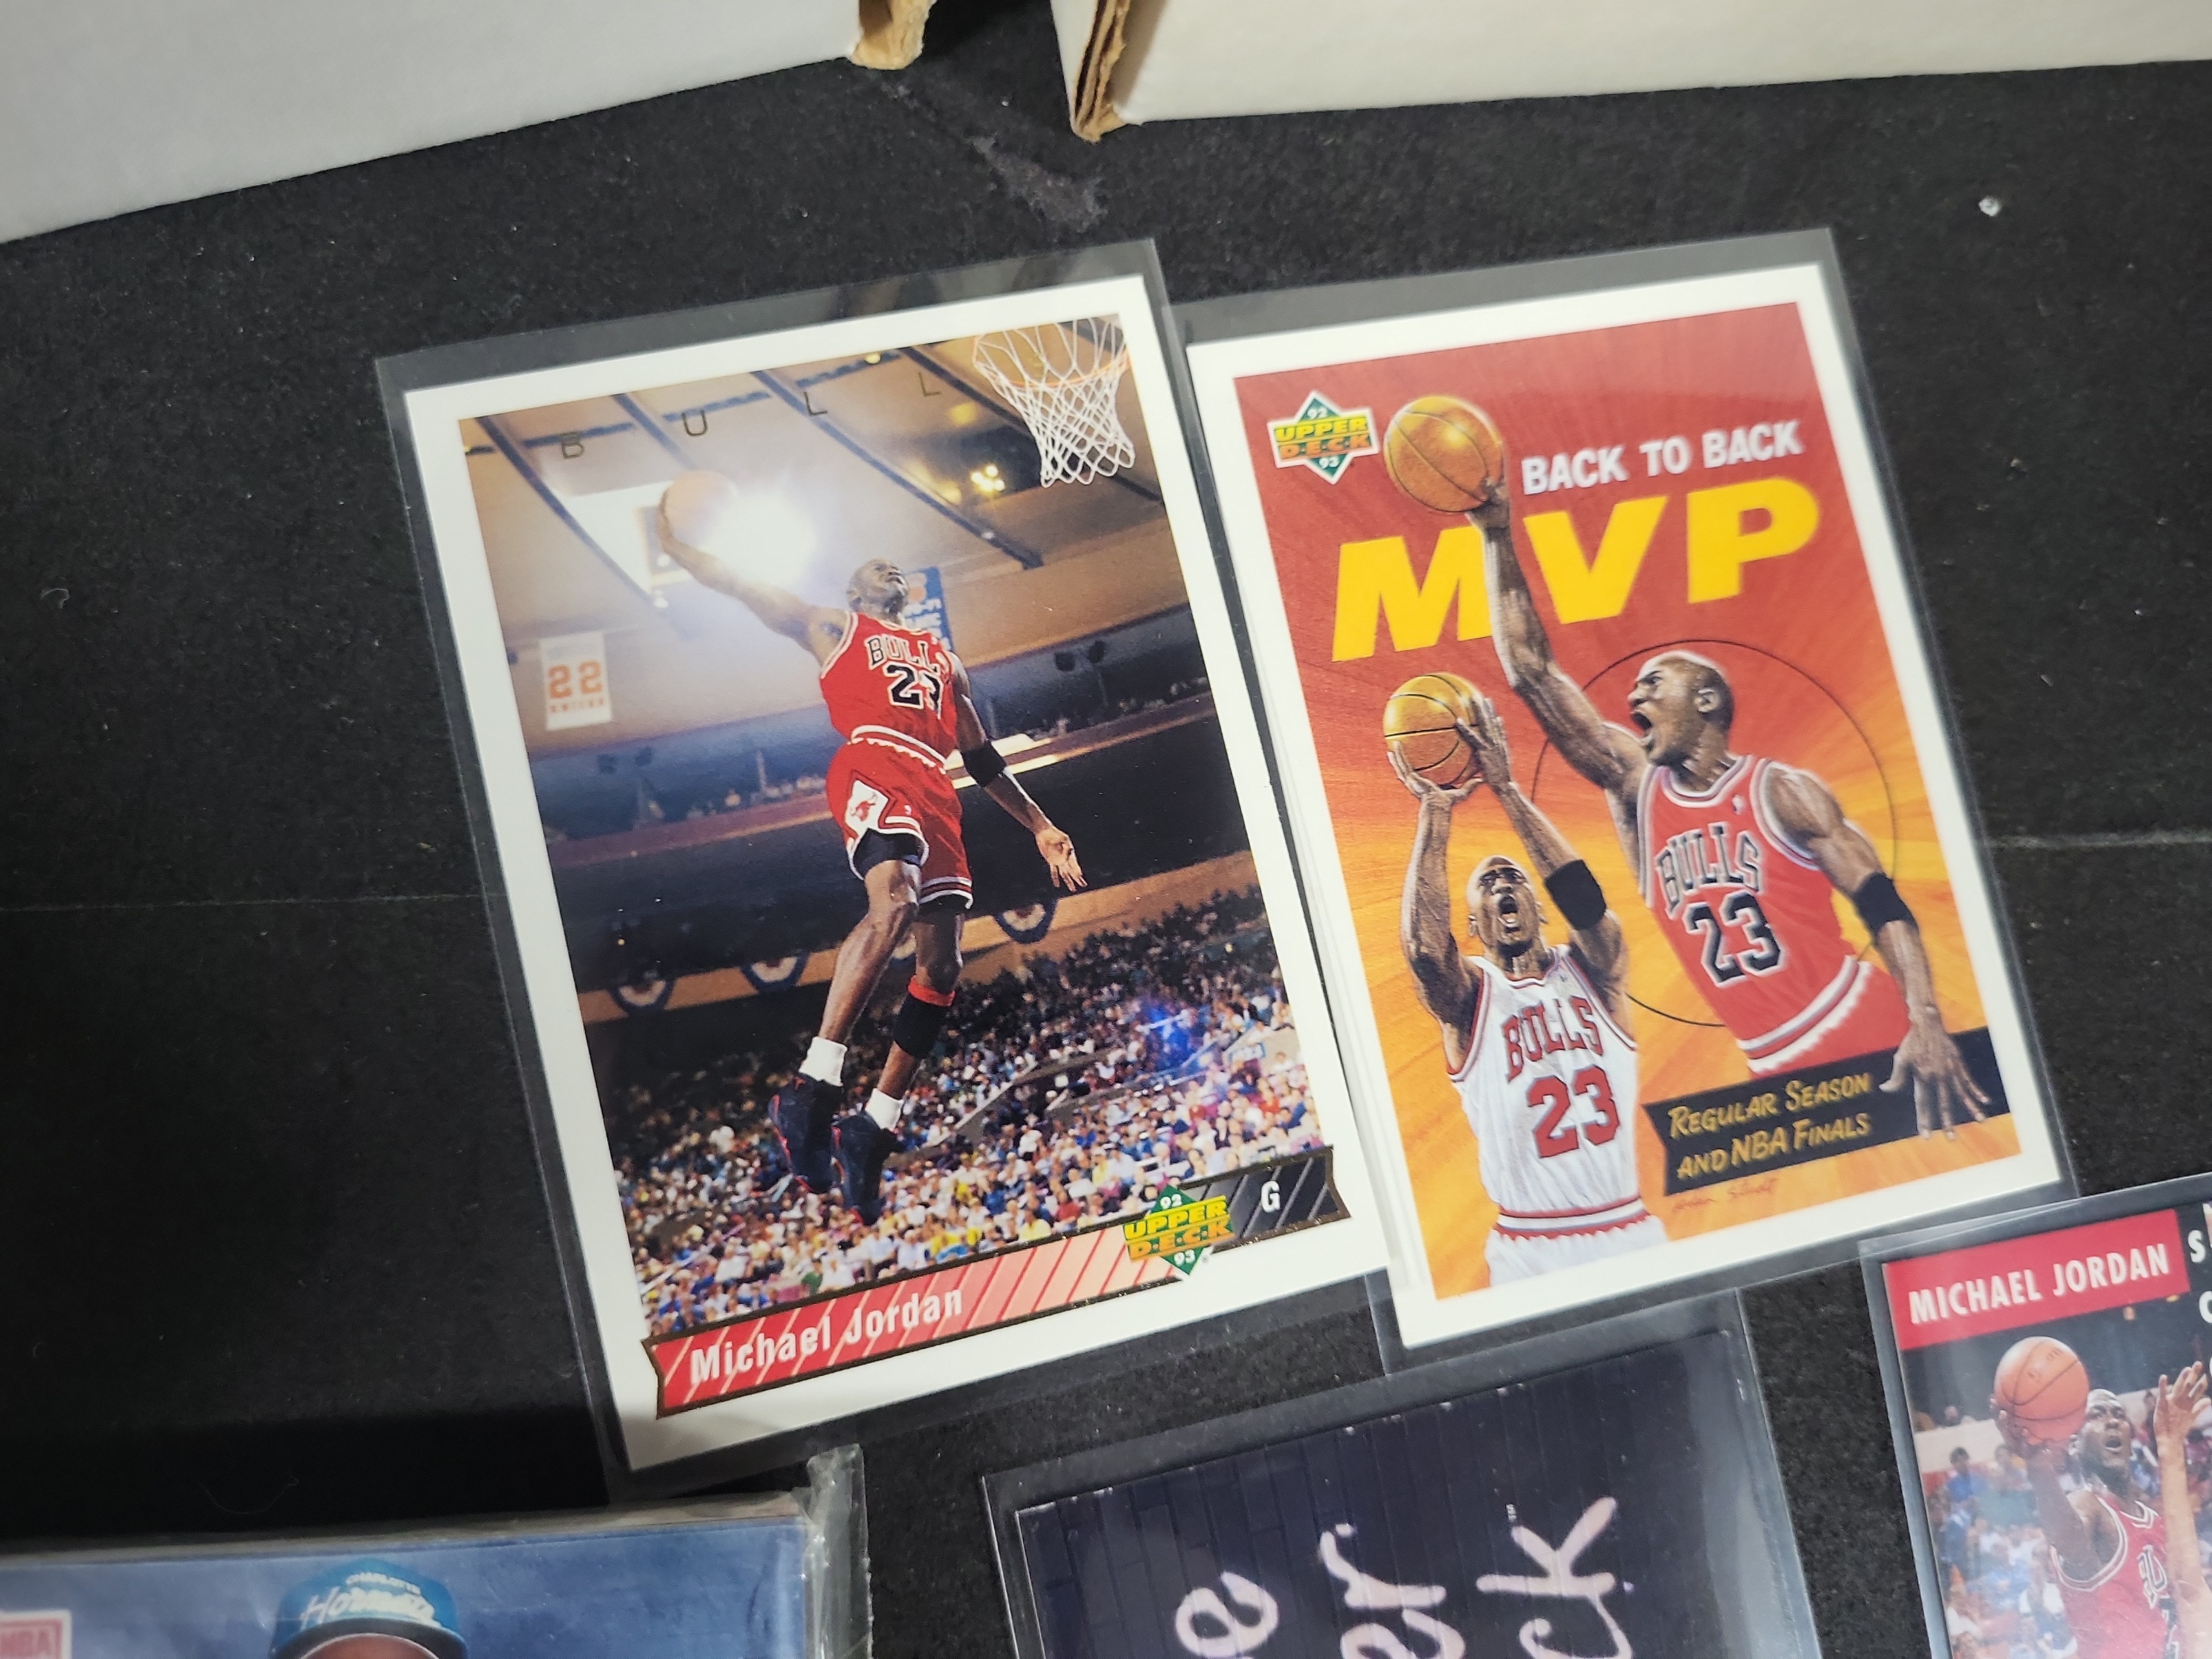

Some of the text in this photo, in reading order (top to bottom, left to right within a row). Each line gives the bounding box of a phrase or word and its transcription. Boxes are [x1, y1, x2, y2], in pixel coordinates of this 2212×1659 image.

[1275, 417, 1368, 442] UPPER
[1318, 456, 1339, 470] 93
[1521, 419, 1804, 495] BACK TO BACK
[1332, 477, 1819, 662] MVP
[549, 661, 603, 699] 22
[1655, 821, 1764, 920] BULLS
[1682, 889, 1787, 987] 23
[1501, 996, 1603, 1083] BULLS
[1527, 1065, 1620, 1159] 23
[1667, 1072, 1873, 1140] REGULAR SEASON
[1676, 1113, 1872, 1180] AND NBA FINALS
[1124, 1201, 1228, 1240] UPPER
[1159, 1193, 1182, 1210] 92
[1260, 1181, 1281, 1213] G
[1173, 1249, 1196, 1266] 93
[1908, 1243, 2169, 1325] MICHAEL JORDAN
[690, 1288, 963, 1385] Michael Jordan
